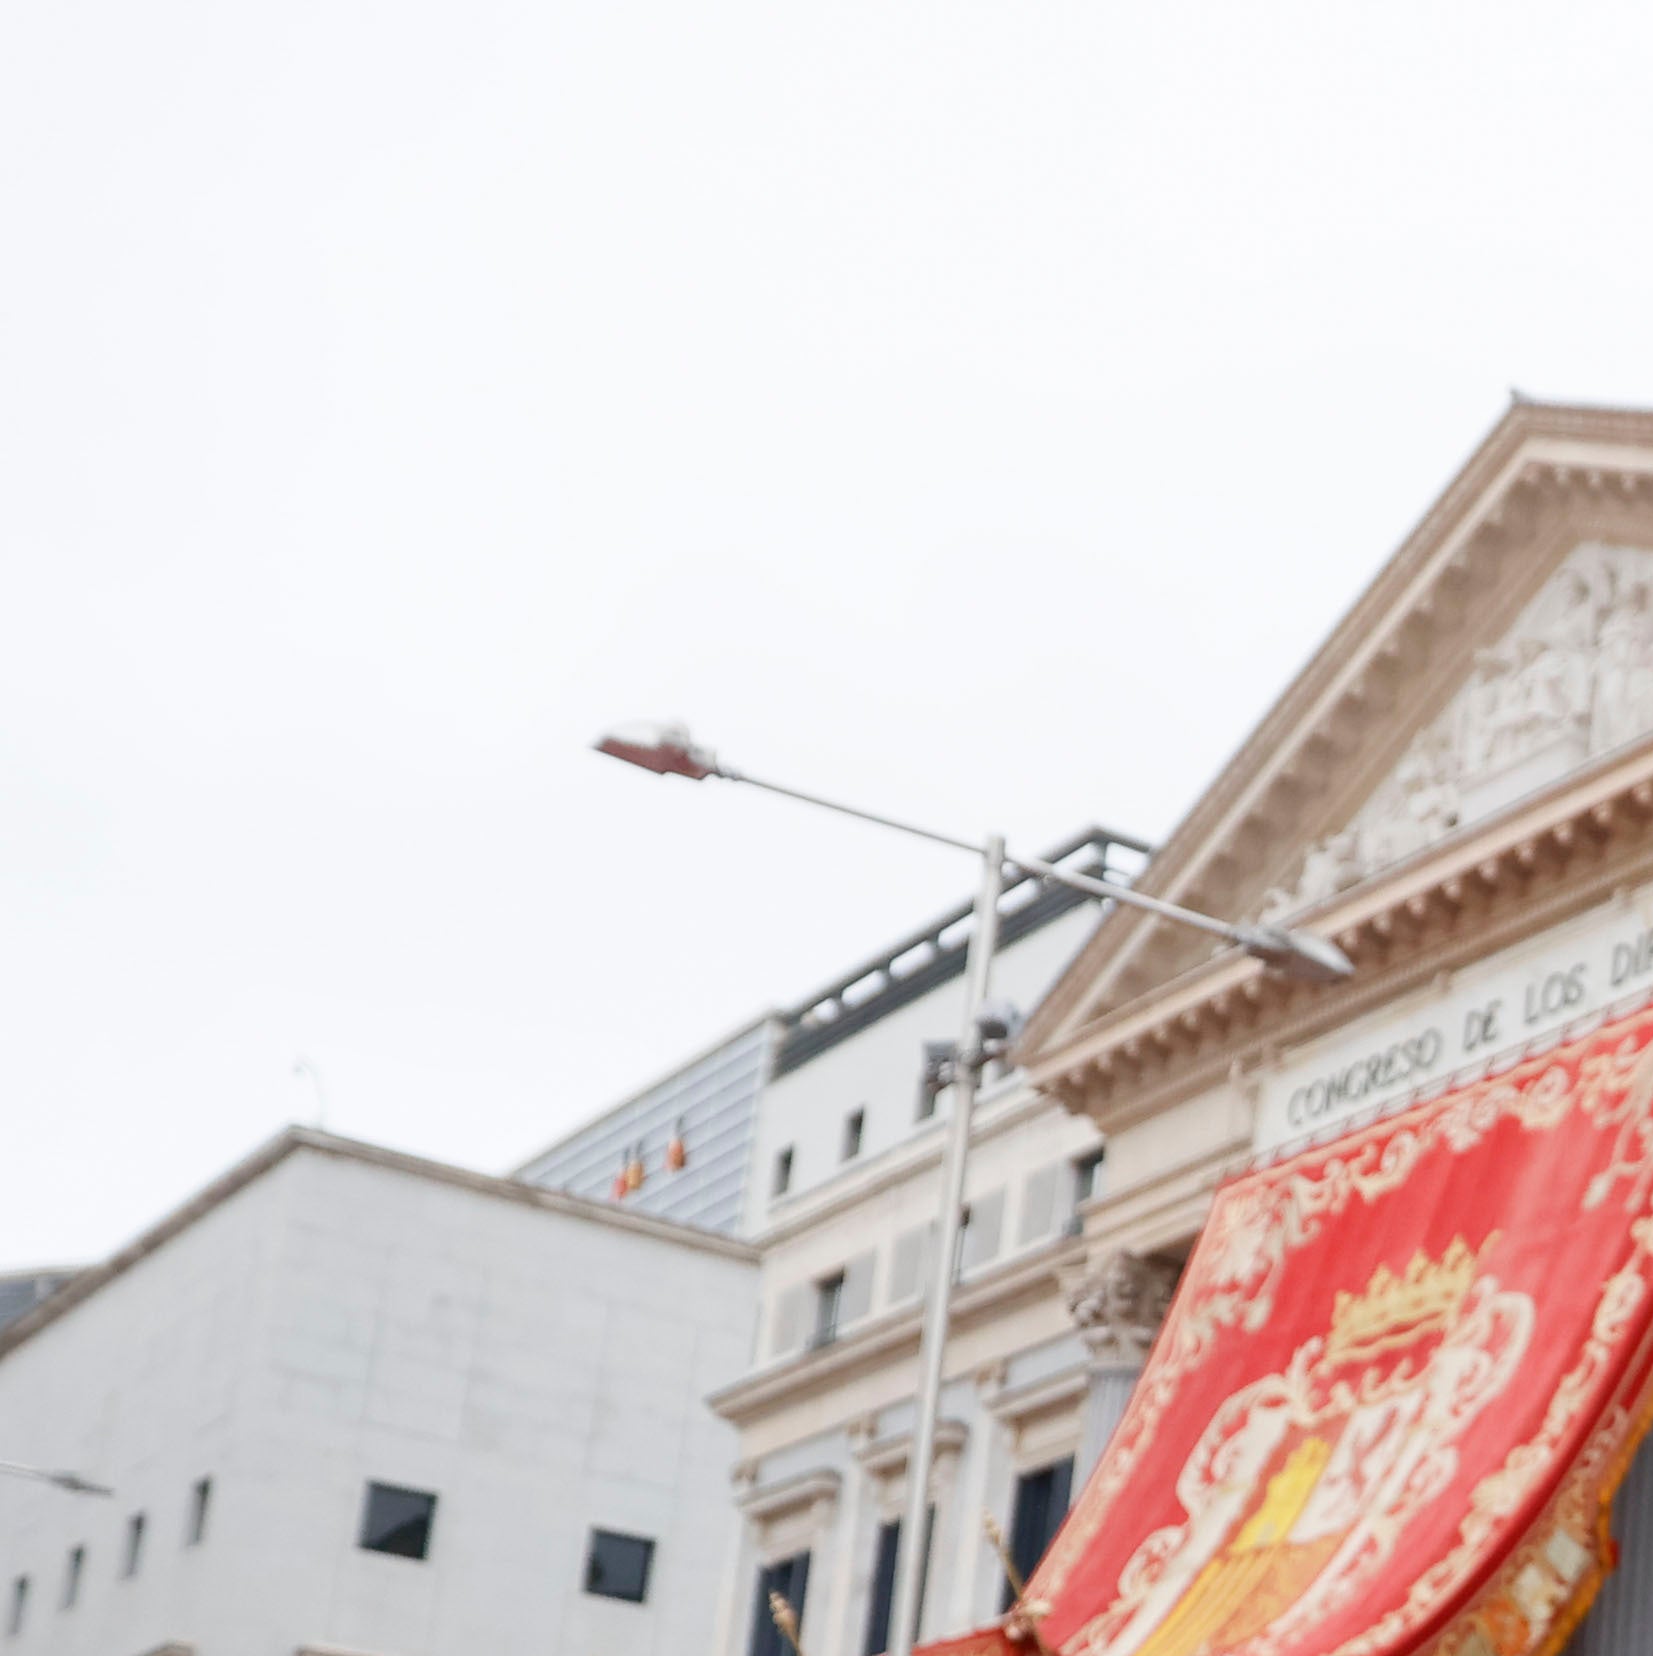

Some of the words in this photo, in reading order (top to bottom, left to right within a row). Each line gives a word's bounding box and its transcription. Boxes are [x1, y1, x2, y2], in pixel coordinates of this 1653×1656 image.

[1287, 1027, 1442, 1126] CONGRESO
[1463, 1000, 1502, 1052] DE
[1524, 963, 1586, 1024] LOS
